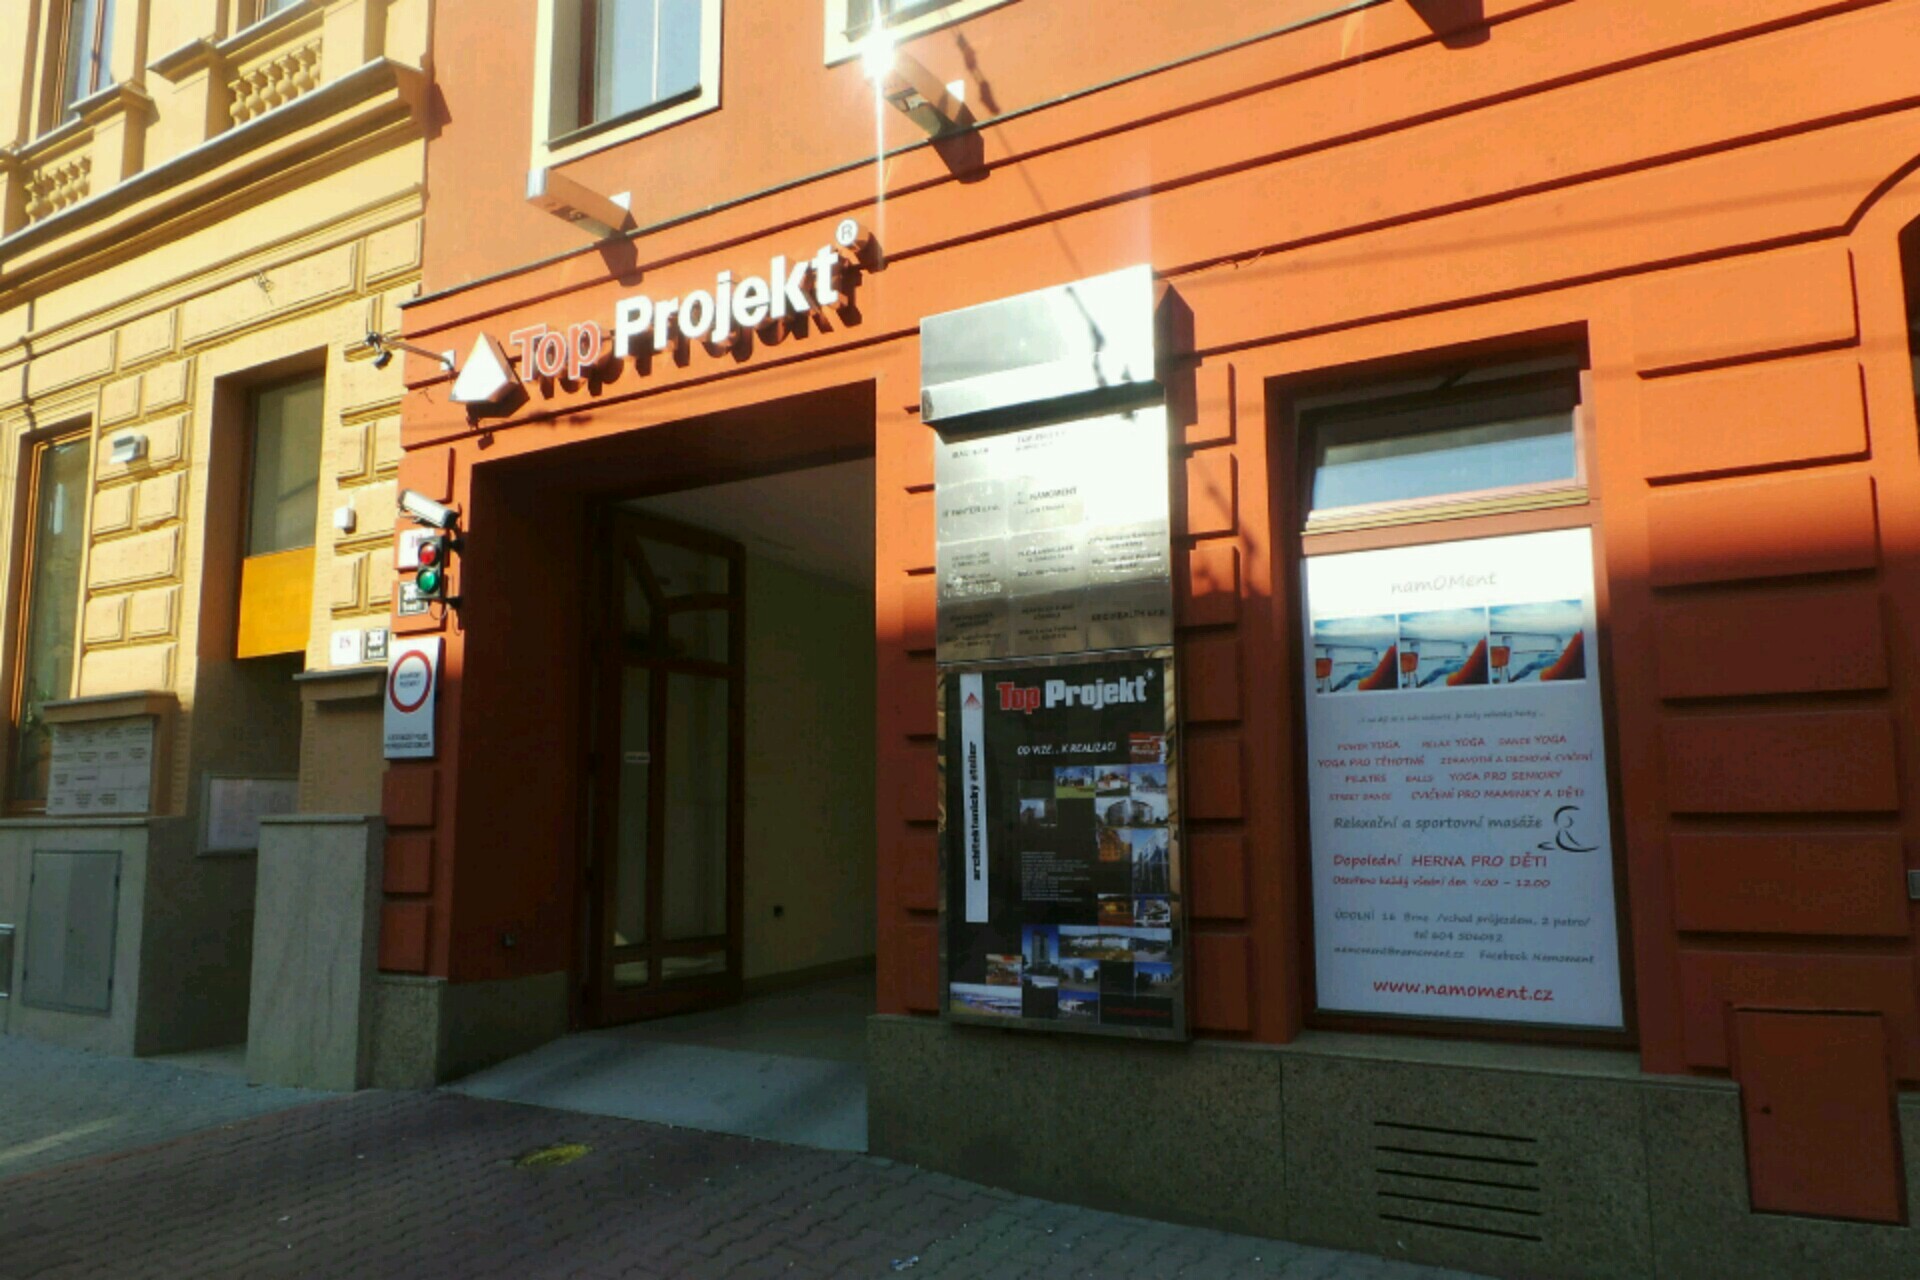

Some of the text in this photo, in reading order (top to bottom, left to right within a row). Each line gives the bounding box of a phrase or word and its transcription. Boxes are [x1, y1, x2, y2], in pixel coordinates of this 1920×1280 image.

[510, 320, 602, 381] Top
[615, 245, 840, 359] Projekt
[1391, 571, 1497, 595] namOMent
[996, 675, 1147, 715] Top Projekt
[1317, 758, 1347, 768] YOGA
[1350, 757, 1371, 767] PRO
[1449, 771, 1480, 782] YOGA
[1483, 771, 1507, 781] PRO
[1457, 788, 1480, 799] PRO
[1484, 787, 1540, 799] MAMINKY
[1544, 789, 1553, 798] A
[1334, 816, 1543, 832] Relaxační a sportovní masáže
[1333, 852, 1548, 869] Dopolední HERNA PRO DĚTI
[1373, 980, 1554, 1002] www.namoment.cz
